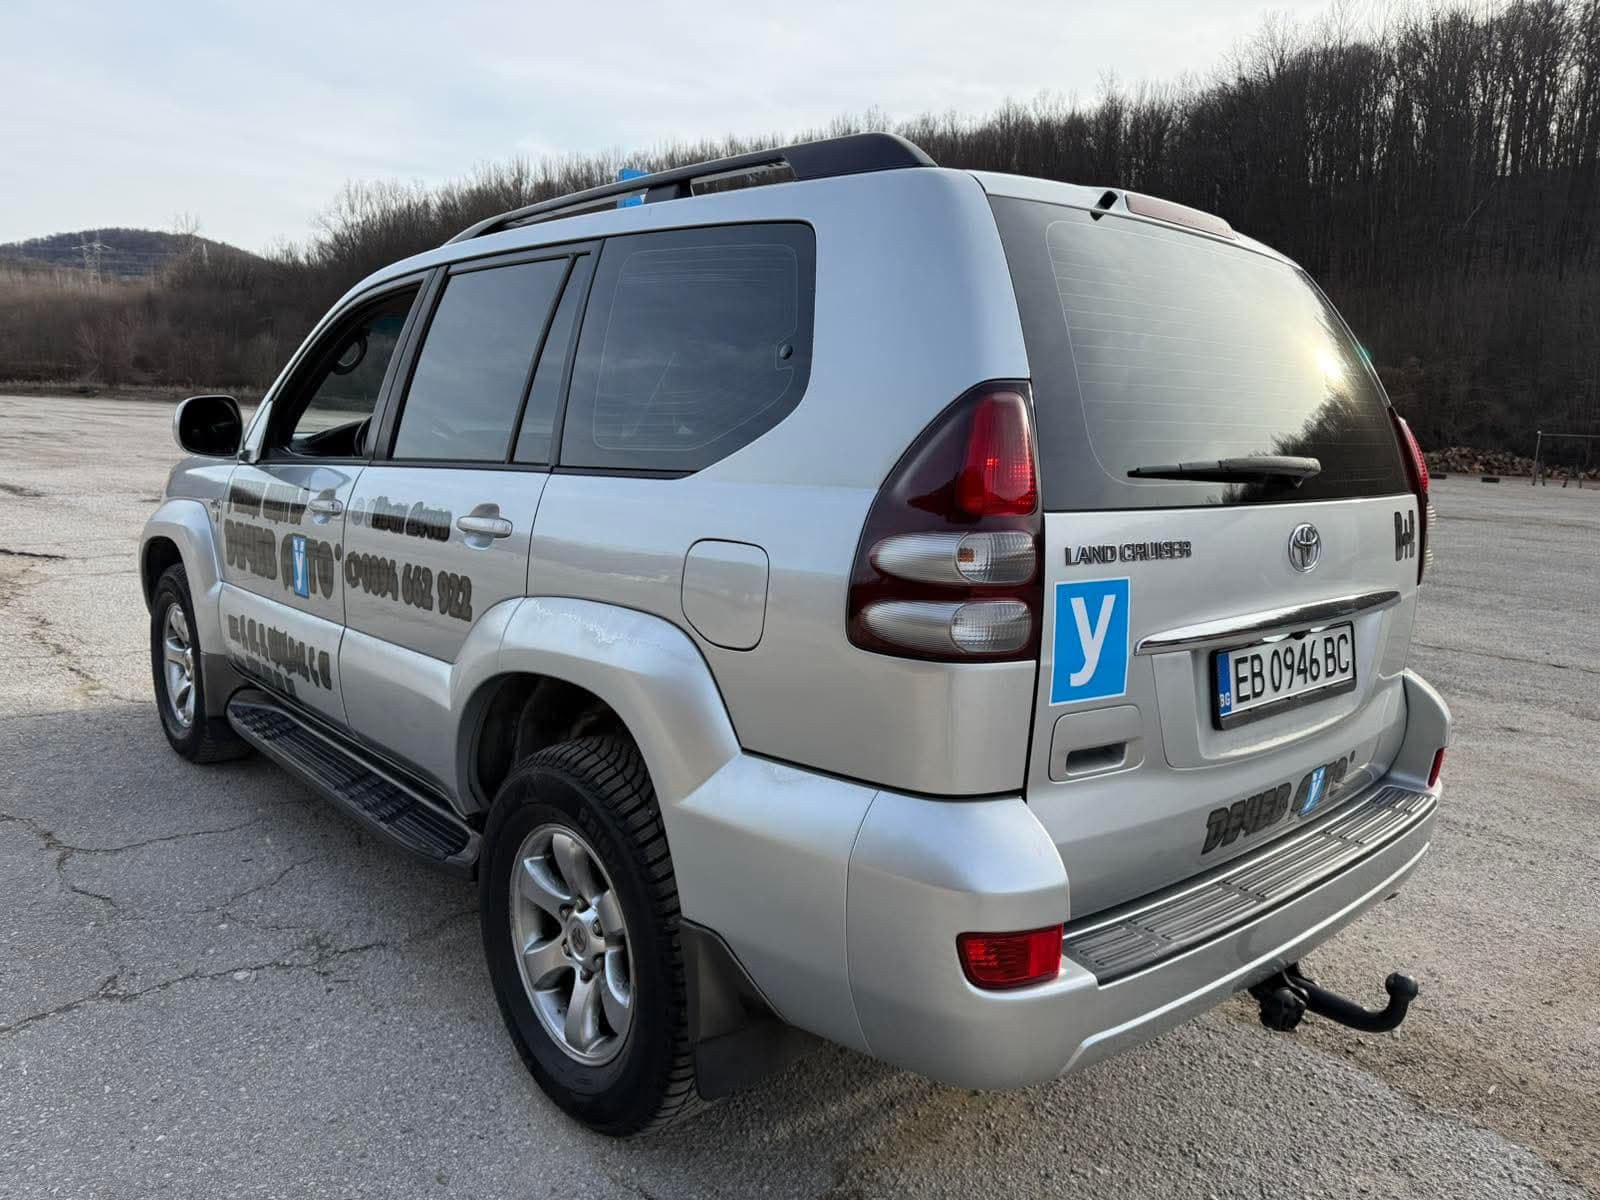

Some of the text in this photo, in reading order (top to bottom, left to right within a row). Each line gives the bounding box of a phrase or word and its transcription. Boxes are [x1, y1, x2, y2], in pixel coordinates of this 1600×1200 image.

[1064, 540, 1192, 566] LAND CRUISER
[1234, 633, 1350, 703] EB 0946 BC
